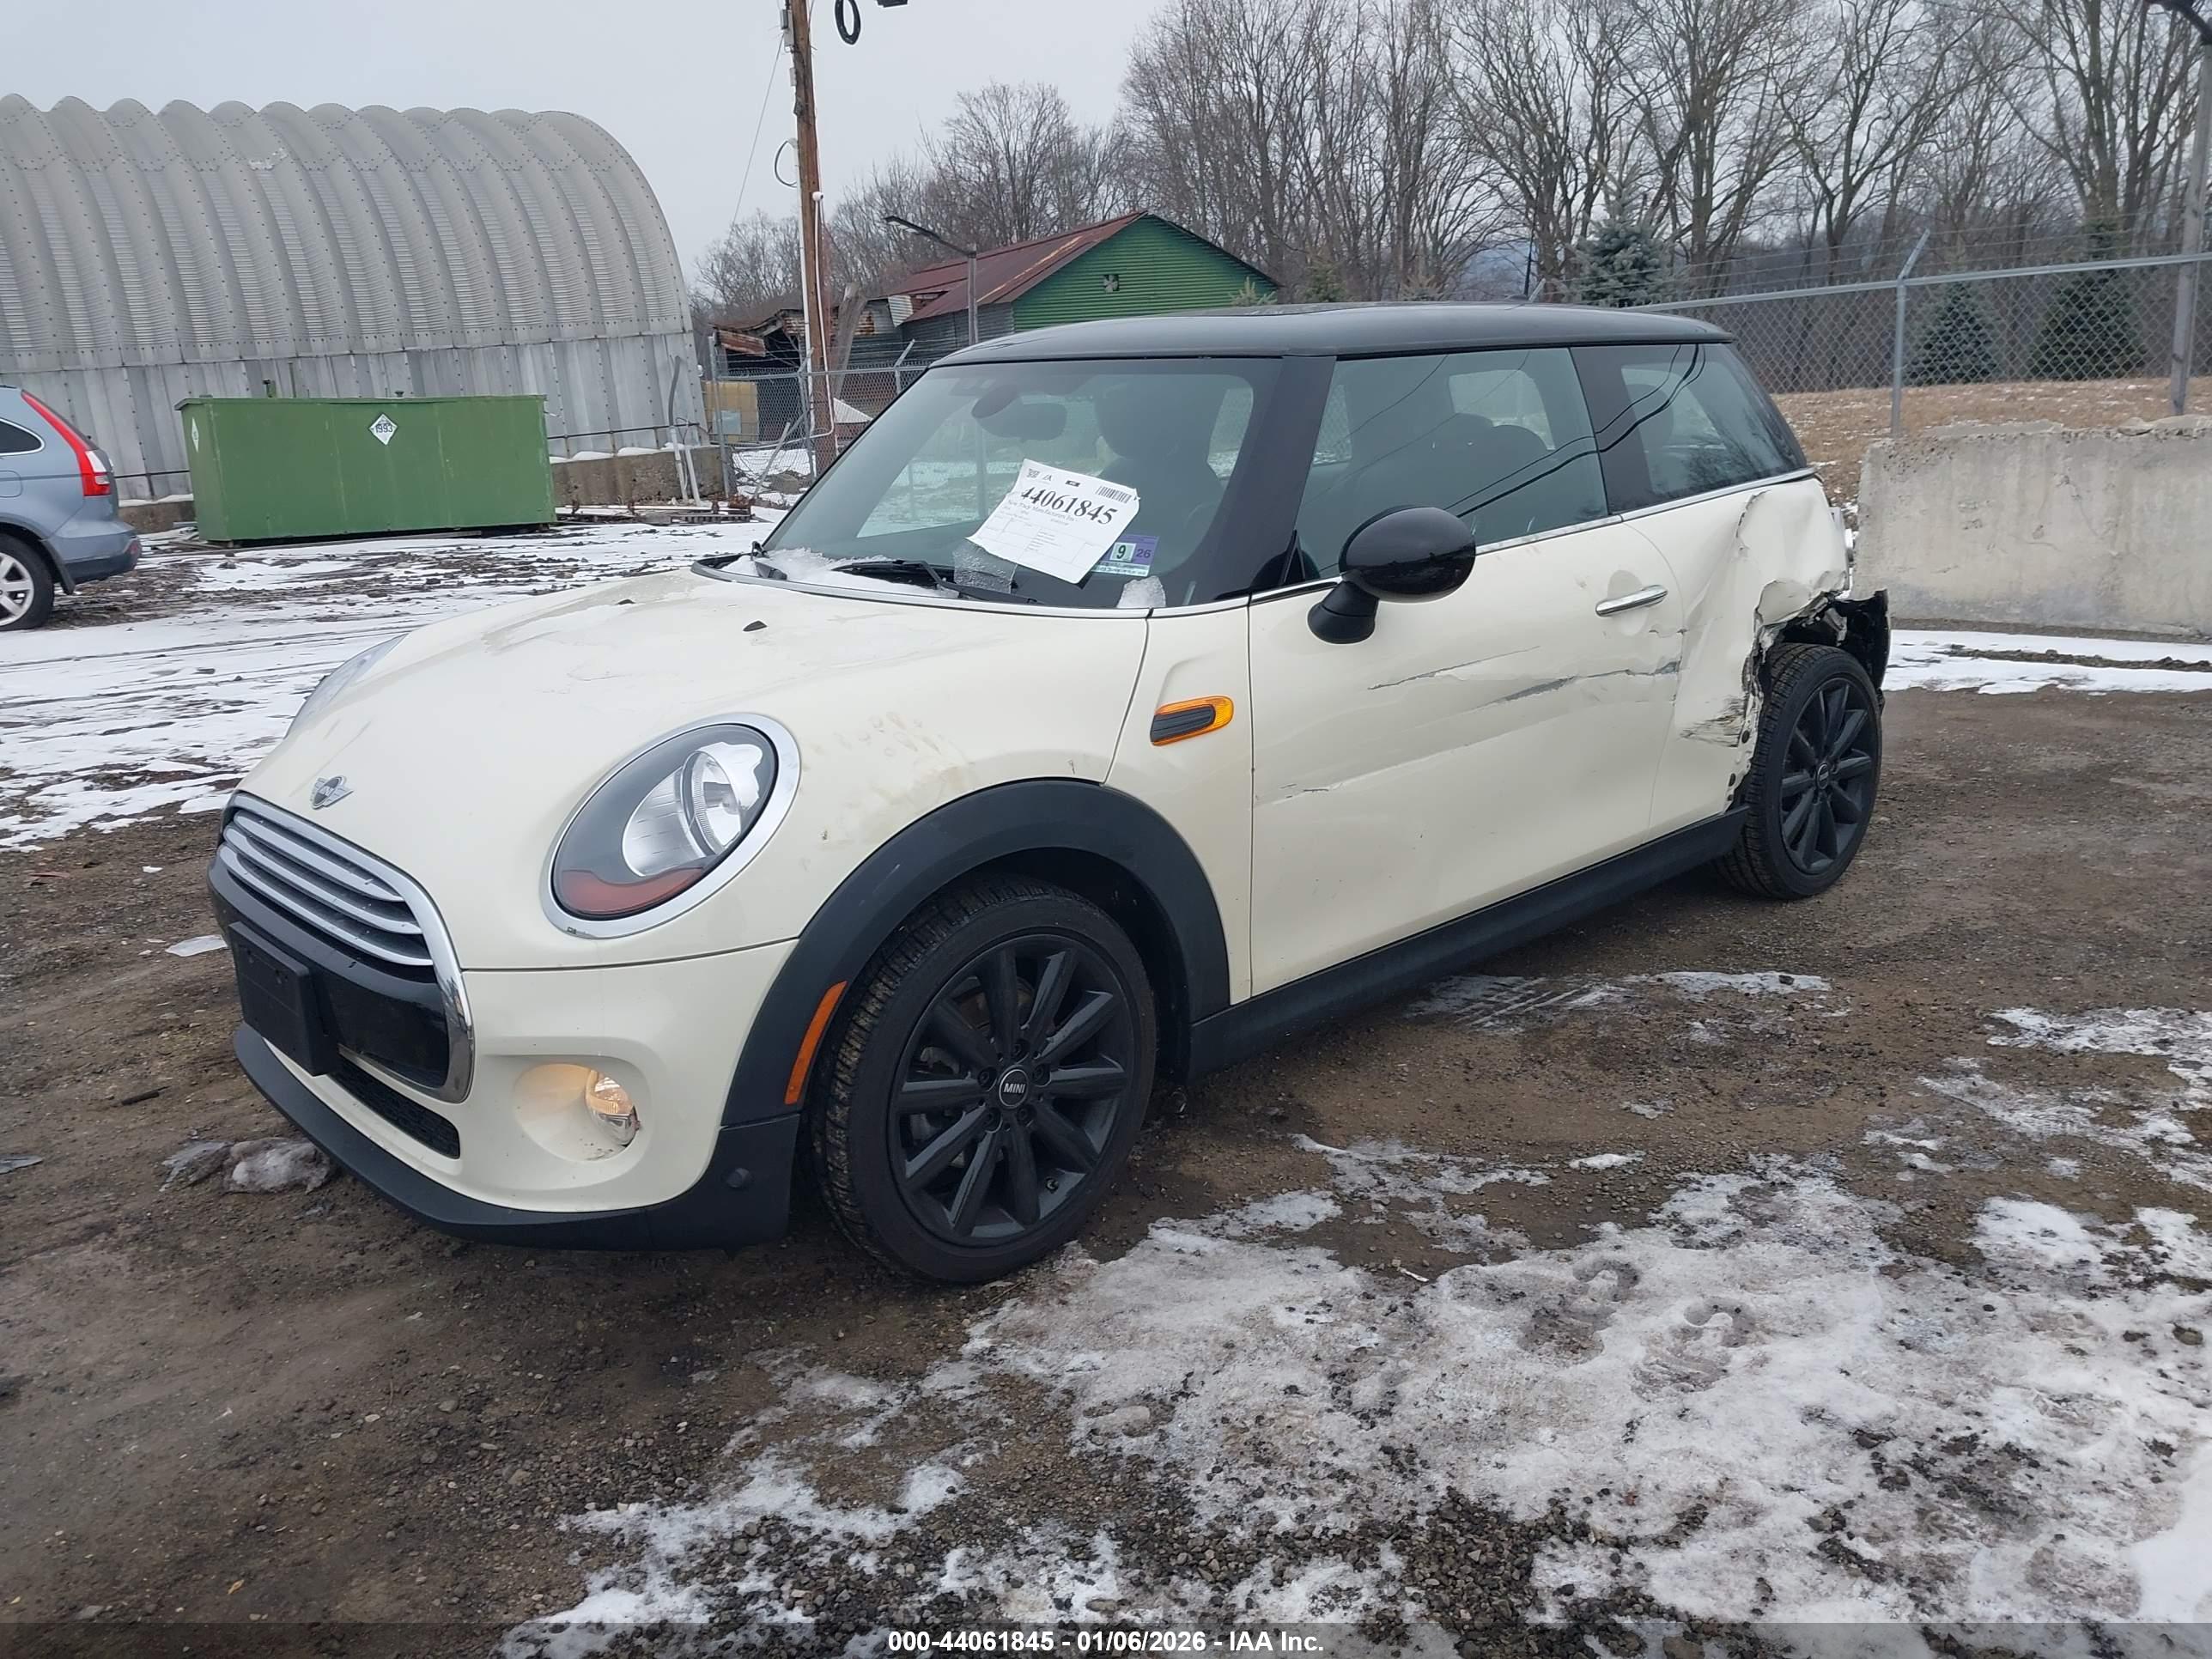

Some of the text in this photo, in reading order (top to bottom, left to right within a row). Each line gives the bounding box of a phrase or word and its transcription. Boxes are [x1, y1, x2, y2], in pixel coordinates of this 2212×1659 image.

[375, 423, 393, 433] 1993
[1021, 487, 1118, 525] 44061845
[1117, 544, 1152, 559] 9 26
[1004, 1083, 1025, 1093] MINI
